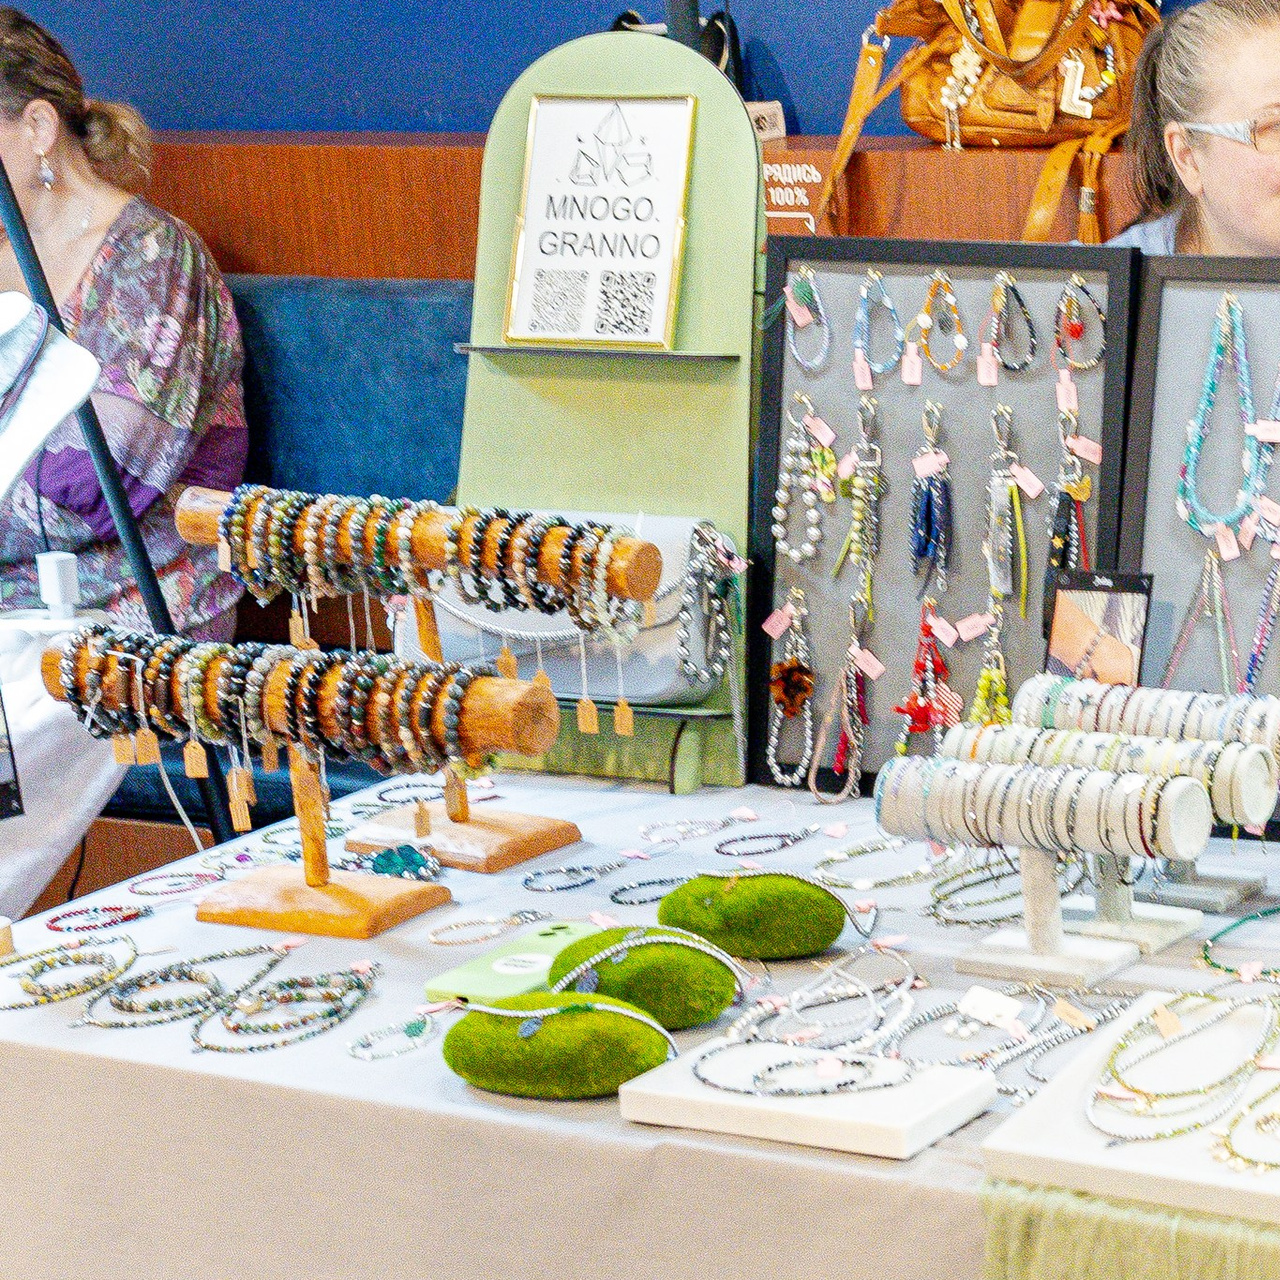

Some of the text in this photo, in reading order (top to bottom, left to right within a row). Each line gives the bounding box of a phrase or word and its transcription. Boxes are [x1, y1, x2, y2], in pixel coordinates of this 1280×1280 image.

[762, 163, 822, 184] РЯДИСЬ
[768, 186, 809, 206] 100%
[538, 231, 661, 260] GRANNO
